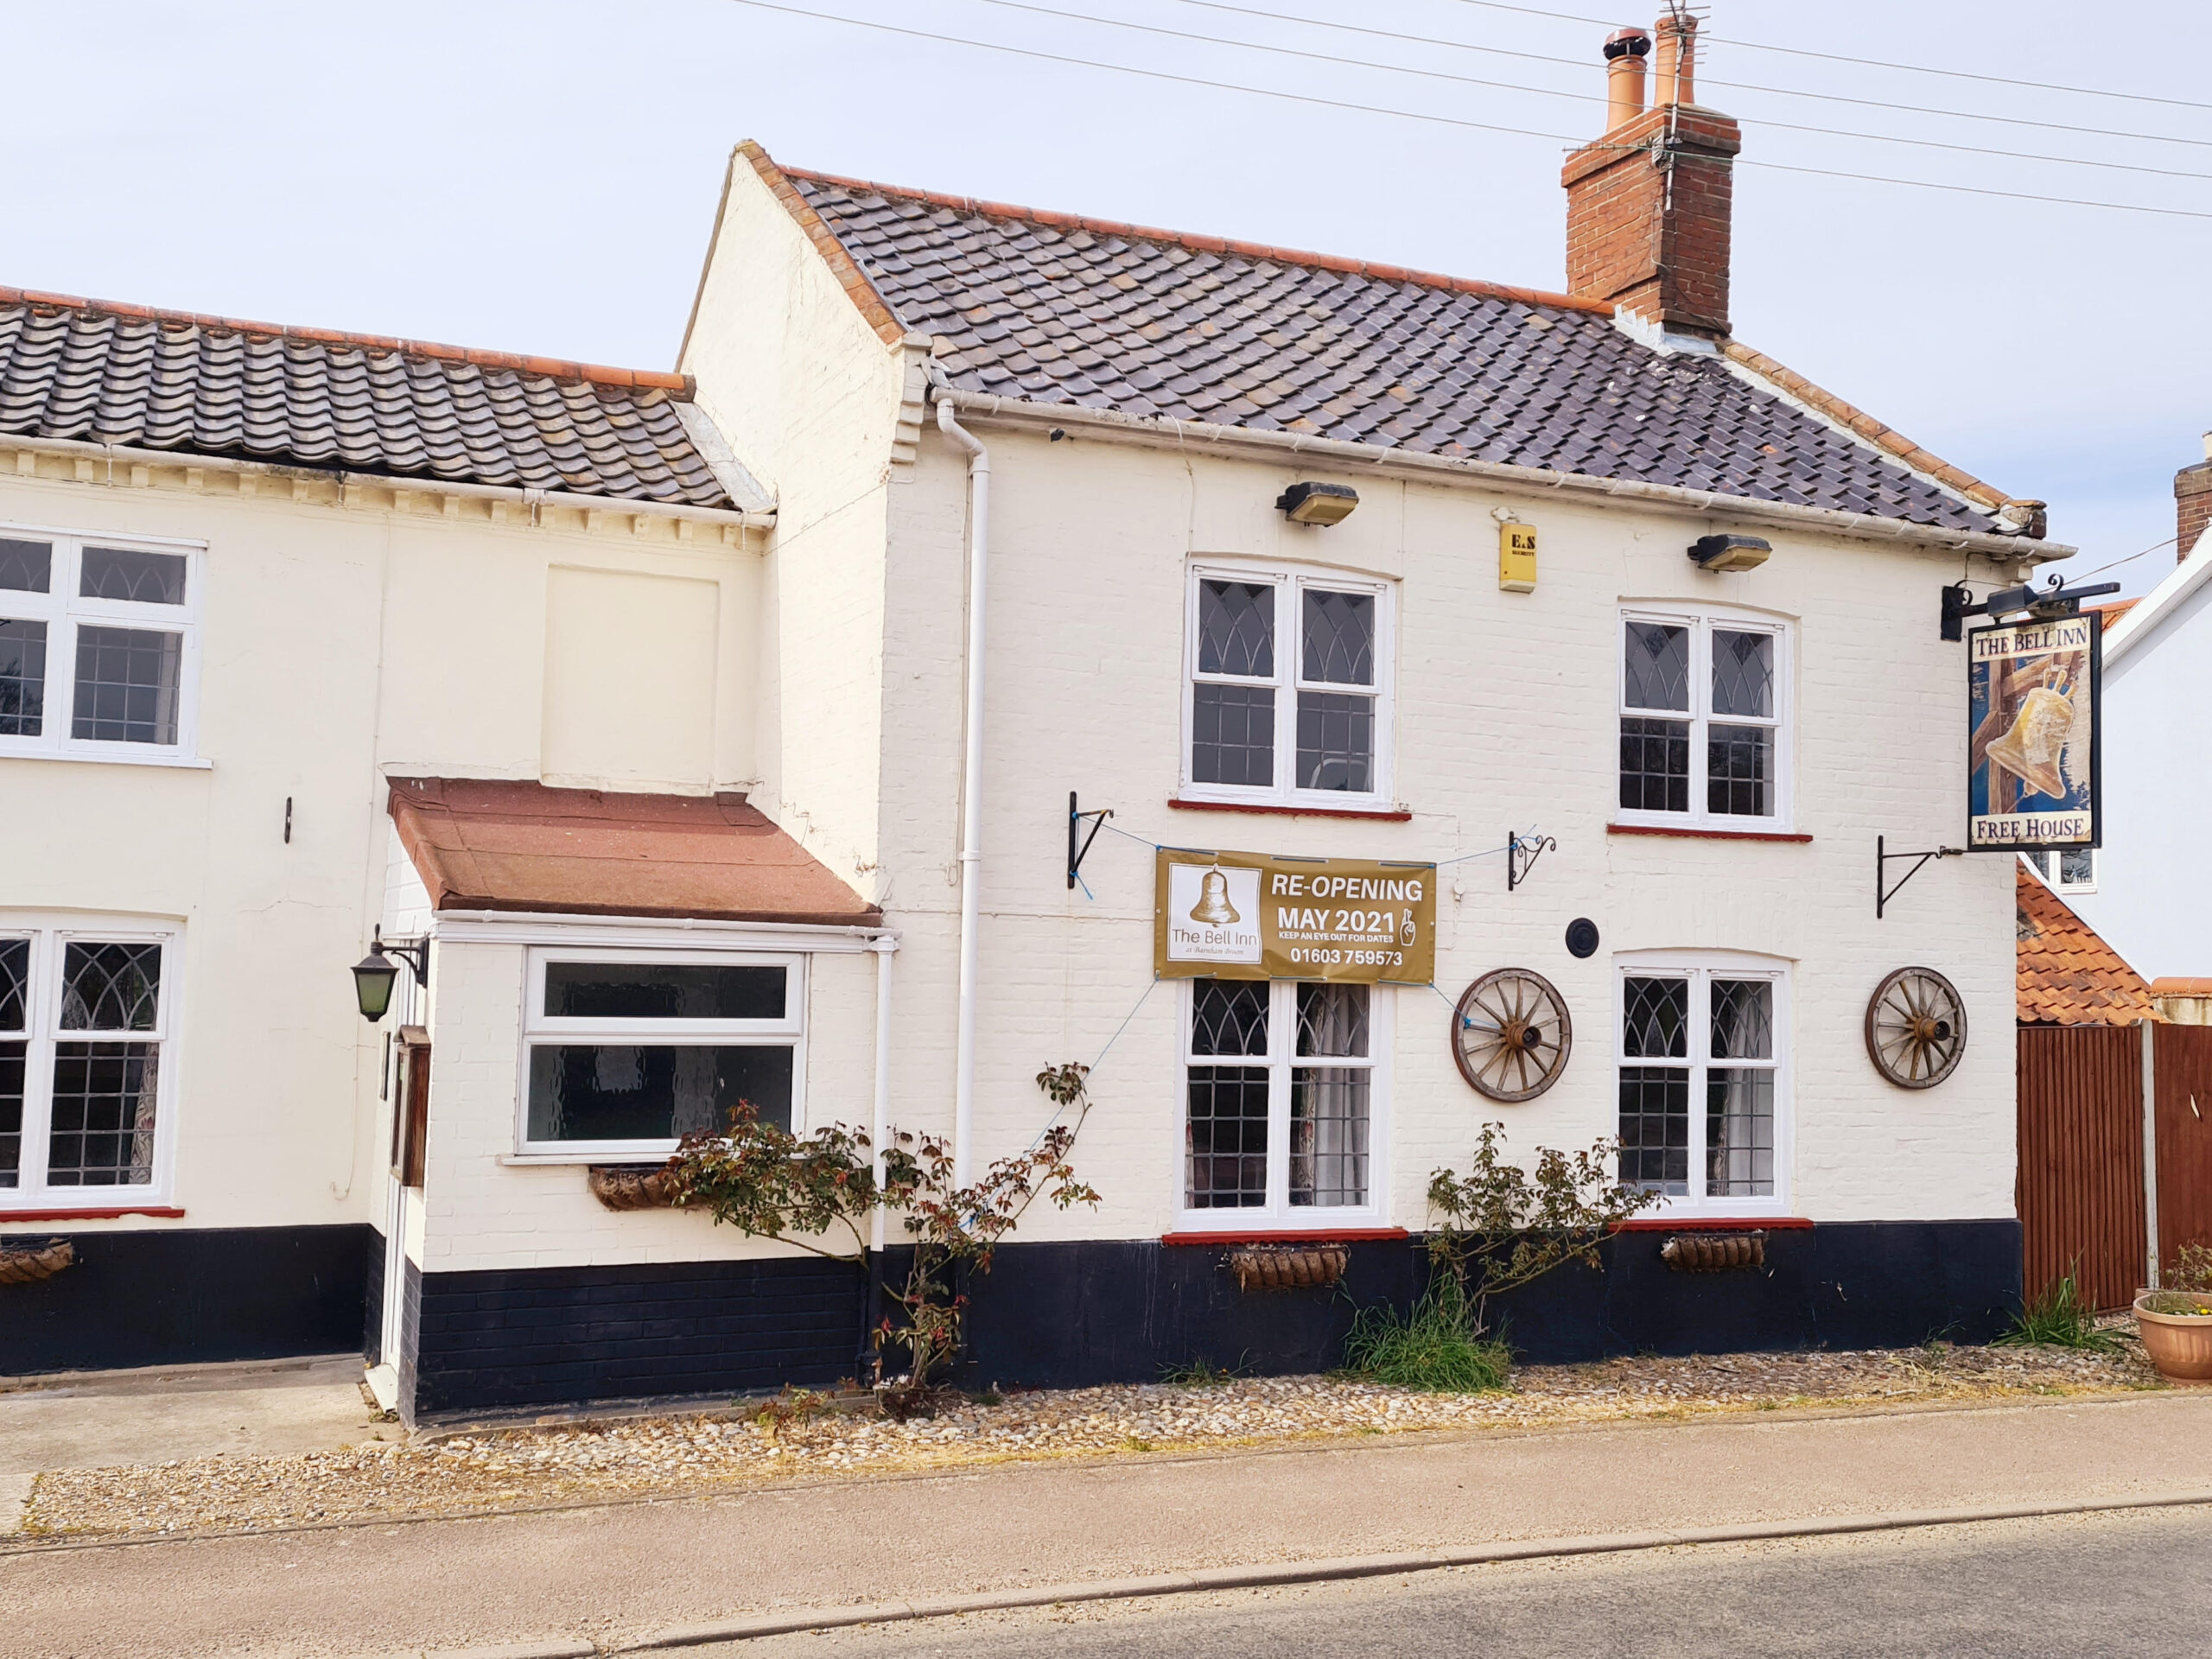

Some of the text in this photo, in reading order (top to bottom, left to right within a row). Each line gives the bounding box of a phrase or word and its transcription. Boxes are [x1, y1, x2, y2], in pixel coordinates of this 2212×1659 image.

[1976, 626, 2087, 657] THE BELL INN
[1977, 818, 2084, 838] FREE HOUSE
[1271, 874, 1423, 902] RE-OPENING
[1278, 906, 1394, 932] MAY 2021
[1172, 928, 1257, 945] The Bell Inn
[1279, 931, 1300, 939] KEEP
[1314, 932, 1330, 941] EYE
[1331, 933, 1347, 942] OUT
[1348, 934, 1365, 943] FOR
[1367, 934, 1394, 944] DATES
[1290, 947, 1402, 966] 01603 759573
